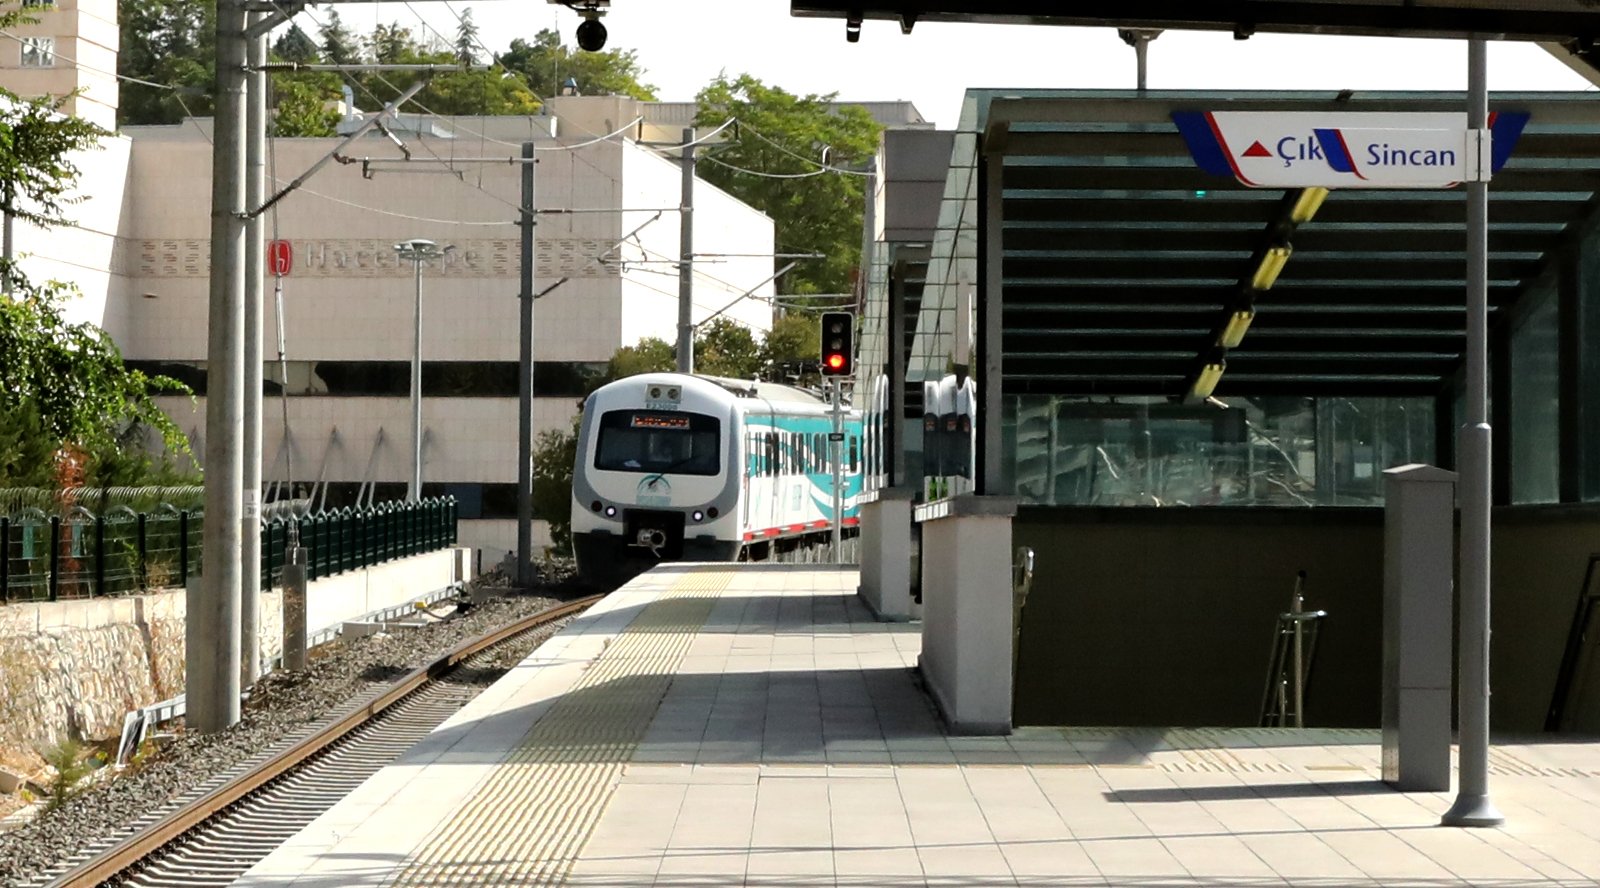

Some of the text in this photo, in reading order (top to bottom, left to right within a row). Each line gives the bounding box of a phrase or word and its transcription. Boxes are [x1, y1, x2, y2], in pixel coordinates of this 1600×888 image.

[1276, 136, 1323, 168] Çık
[1366, 143, 1456, 166] Sincan
[305, 242, 481, 275] Hacetpe
